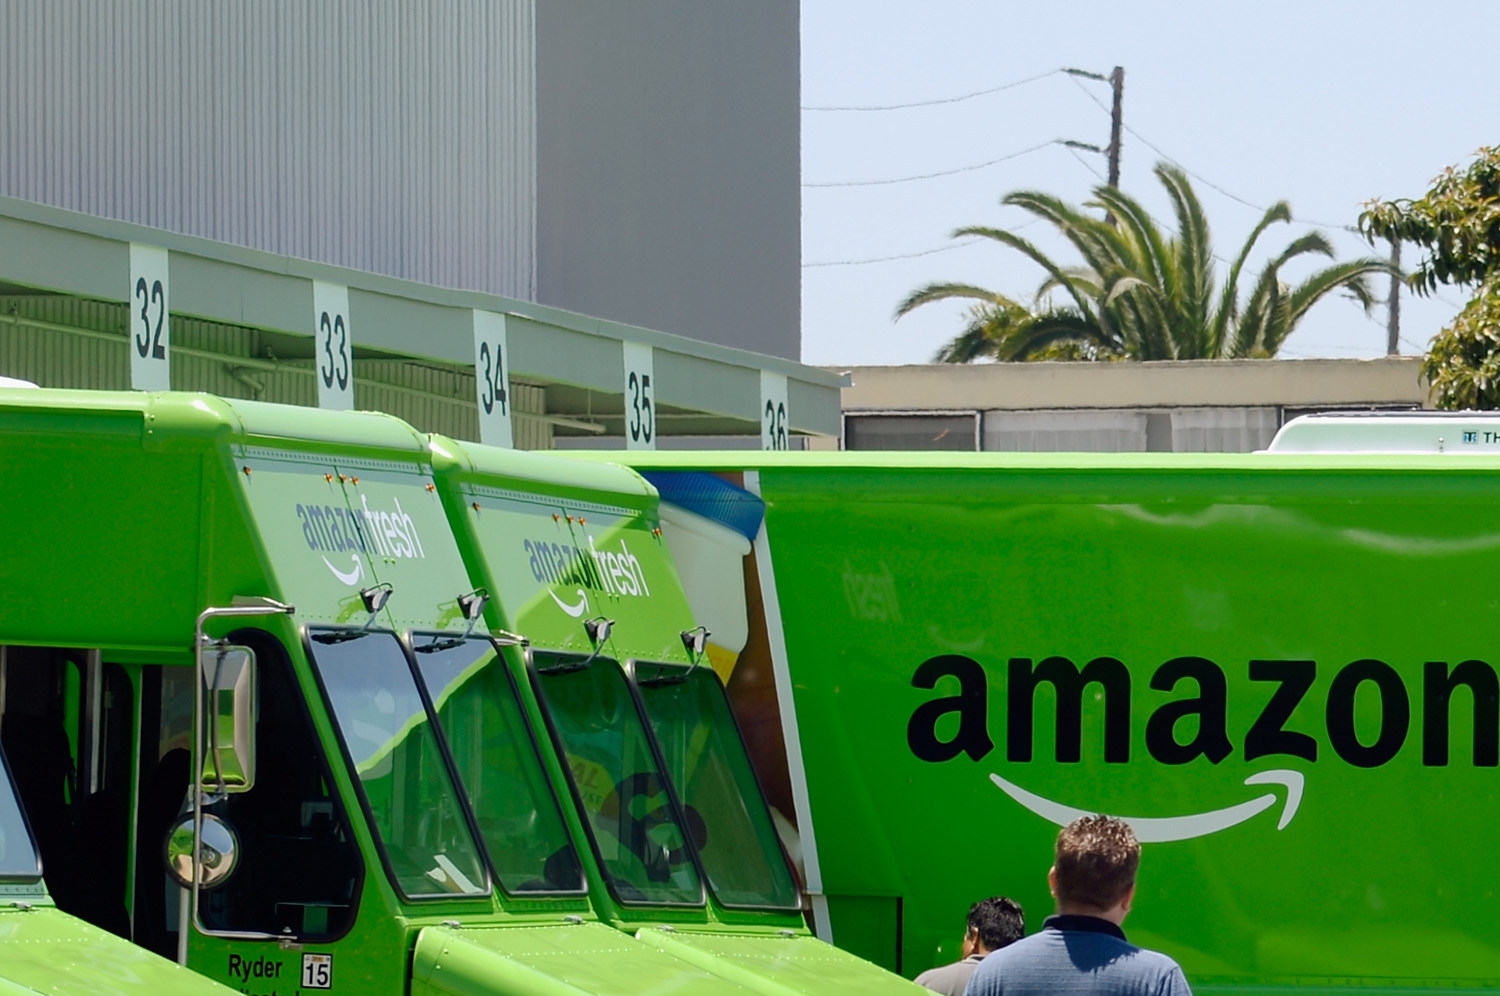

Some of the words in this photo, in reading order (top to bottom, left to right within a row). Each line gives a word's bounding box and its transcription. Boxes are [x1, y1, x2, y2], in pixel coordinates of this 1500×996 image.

[136, 277, 165, 360] 32
[321, 312, 348, 391] 33
[480, 342, 506, 416] 34
[629, 371, 652, 443] 35
[765, 400, 787, 450] 36
[296, 494, 425, 559] amazonfresh
[524, 535, 650, 597] amazonfresh
[229, 954, 282, 983] Ryder
[306, 963, 328, 986] 15
